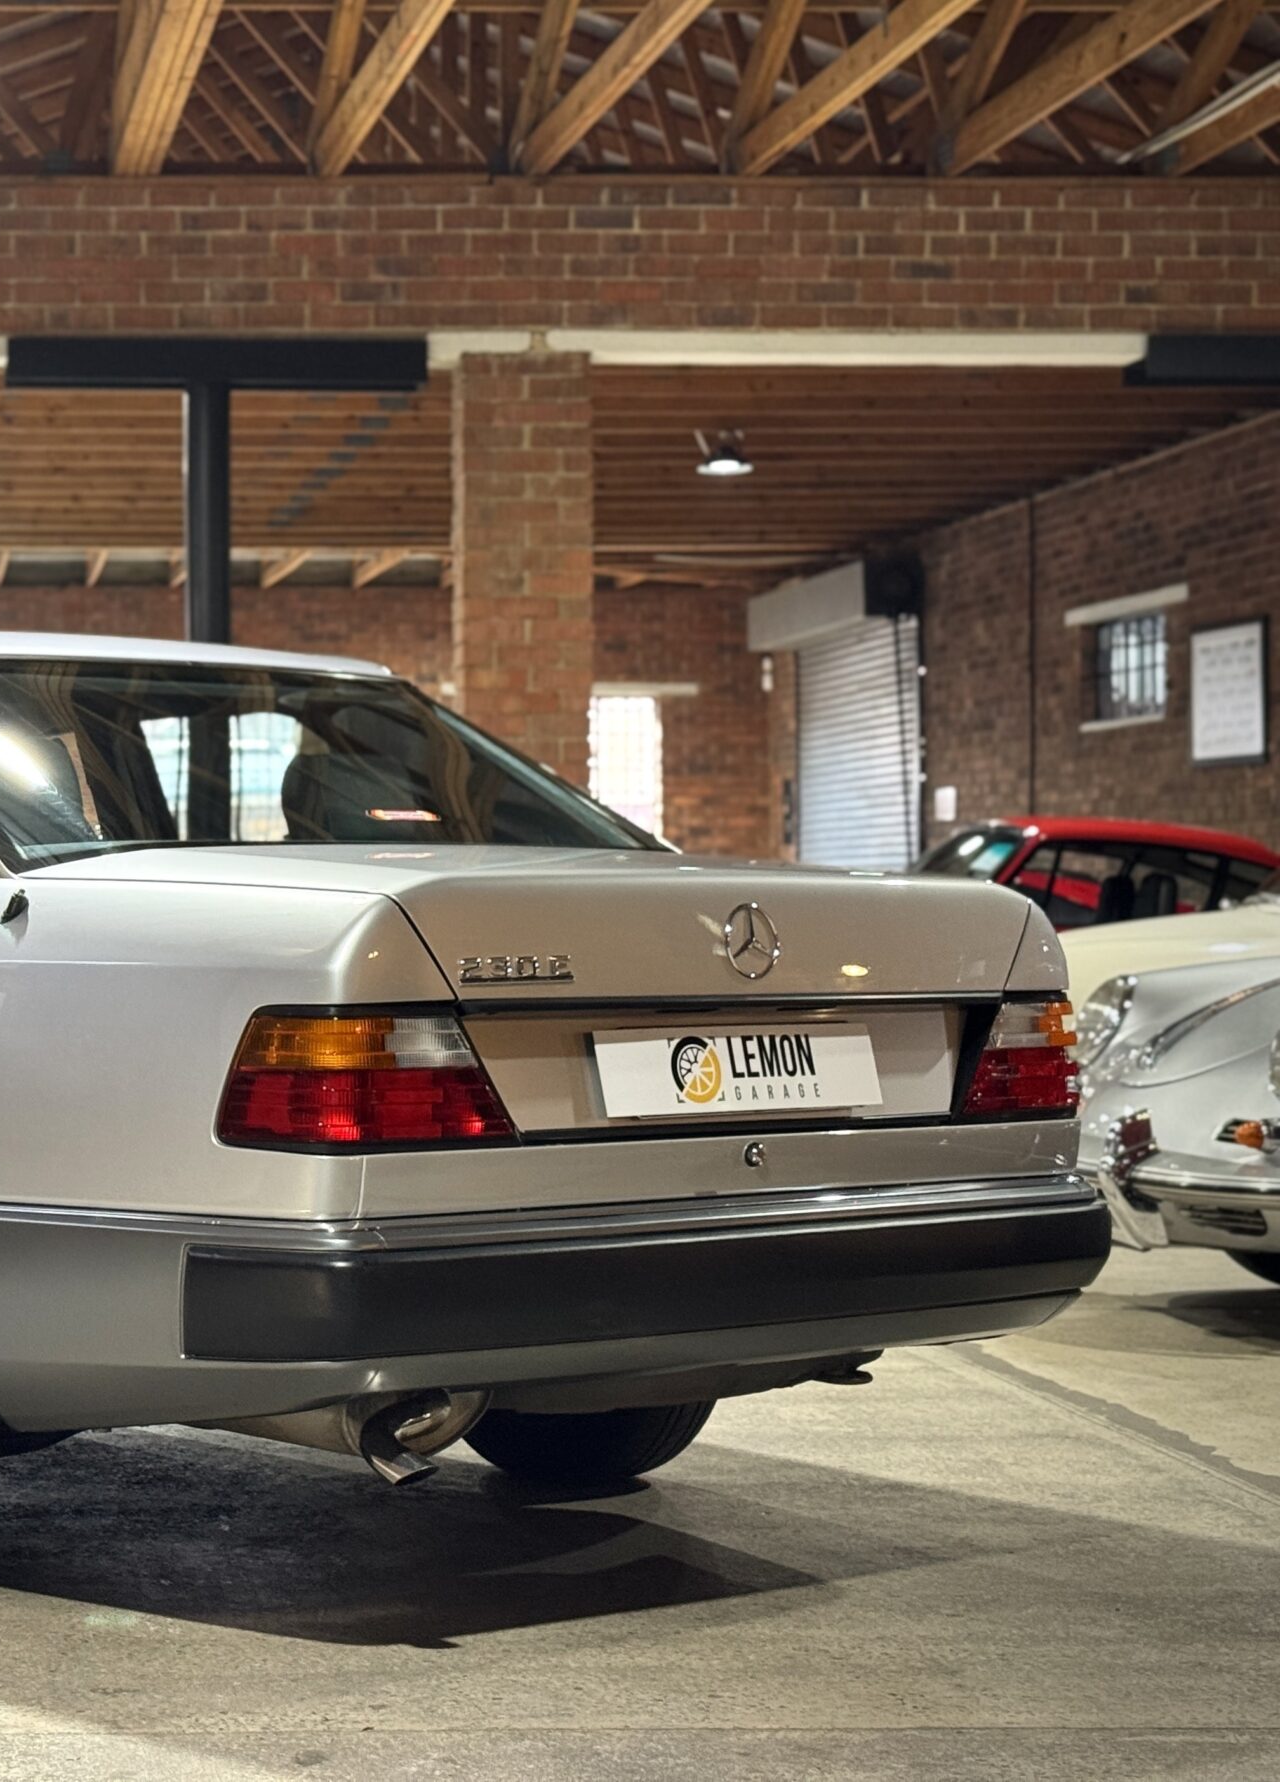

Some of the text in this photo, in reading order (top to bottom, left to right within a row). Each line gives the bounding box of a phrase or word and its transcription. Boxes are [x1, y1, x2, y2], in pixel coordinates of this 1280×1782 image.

[458, 955, 541, 977] 230
[726, 1034, 816, 1078] LEMON
[734, 1083, 821, 1101] GARAGE
